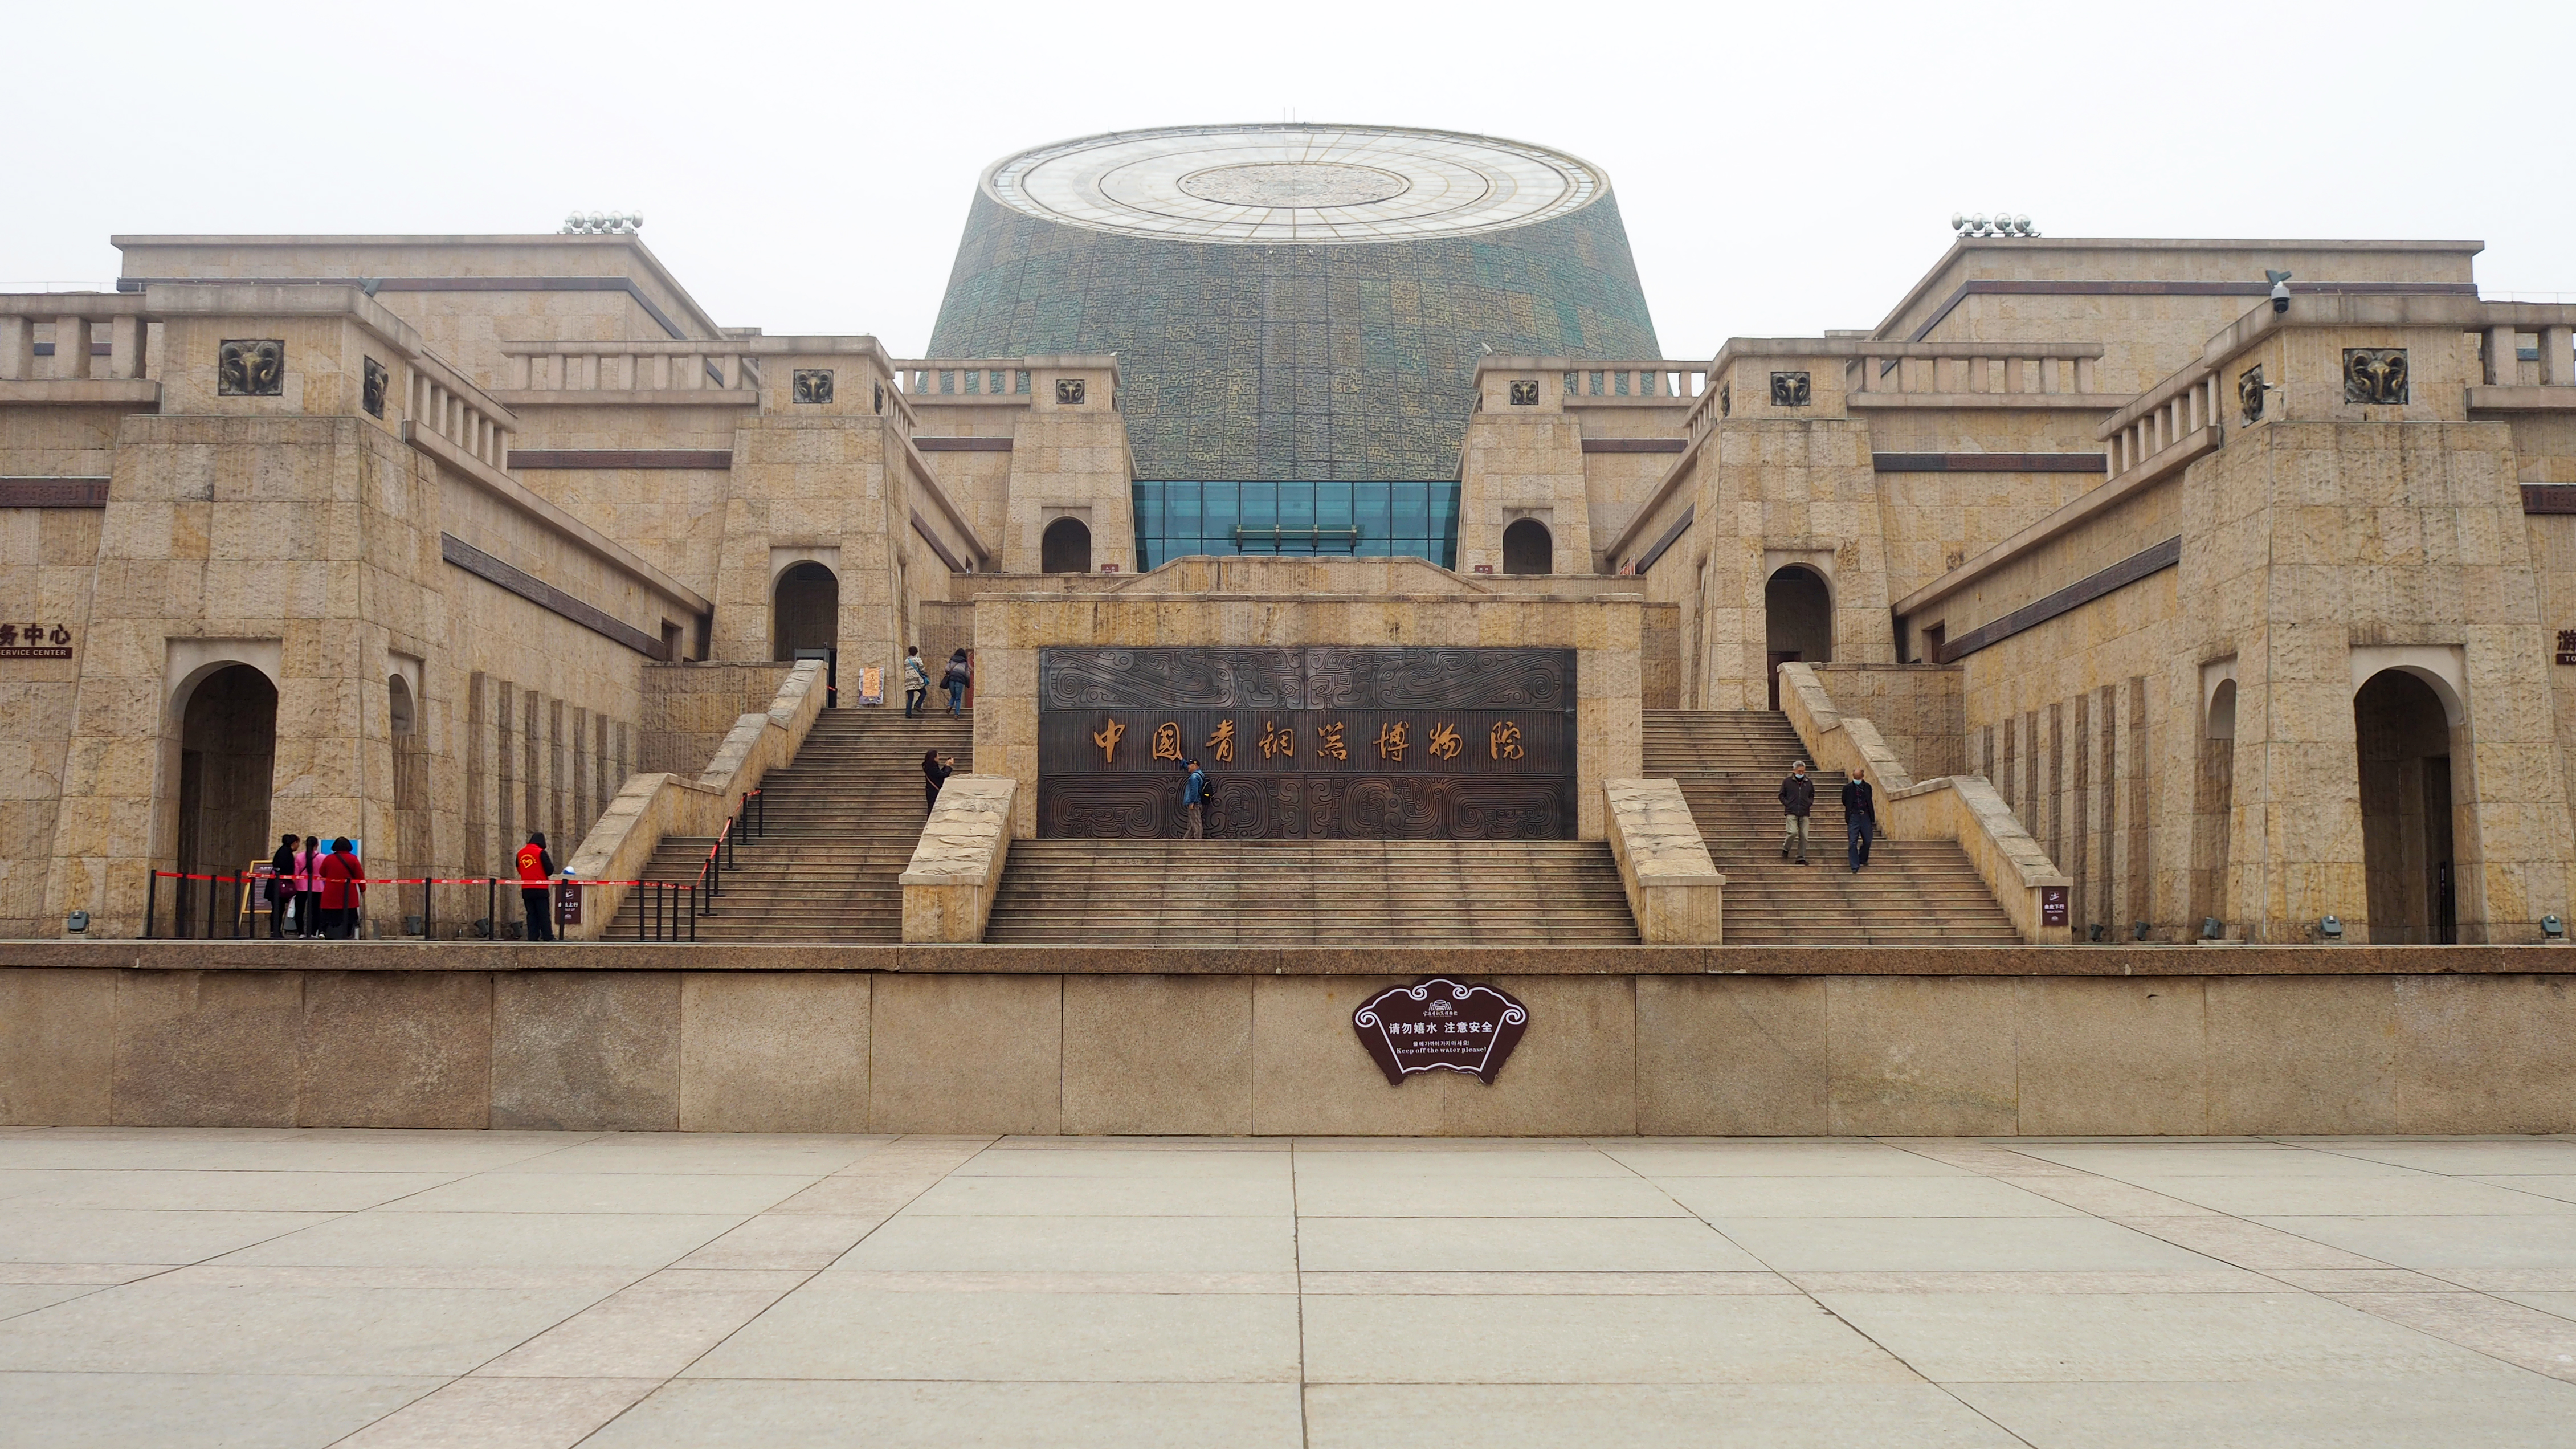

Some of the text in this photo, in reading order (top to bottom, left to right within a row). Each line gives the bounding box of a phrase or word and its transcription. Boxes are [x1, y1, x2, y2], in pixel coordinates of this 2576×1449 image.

[0, 623, 71, 646] 务中心
[1389, 1021, 1493, 1035] 请勿嬉水 注意安全
